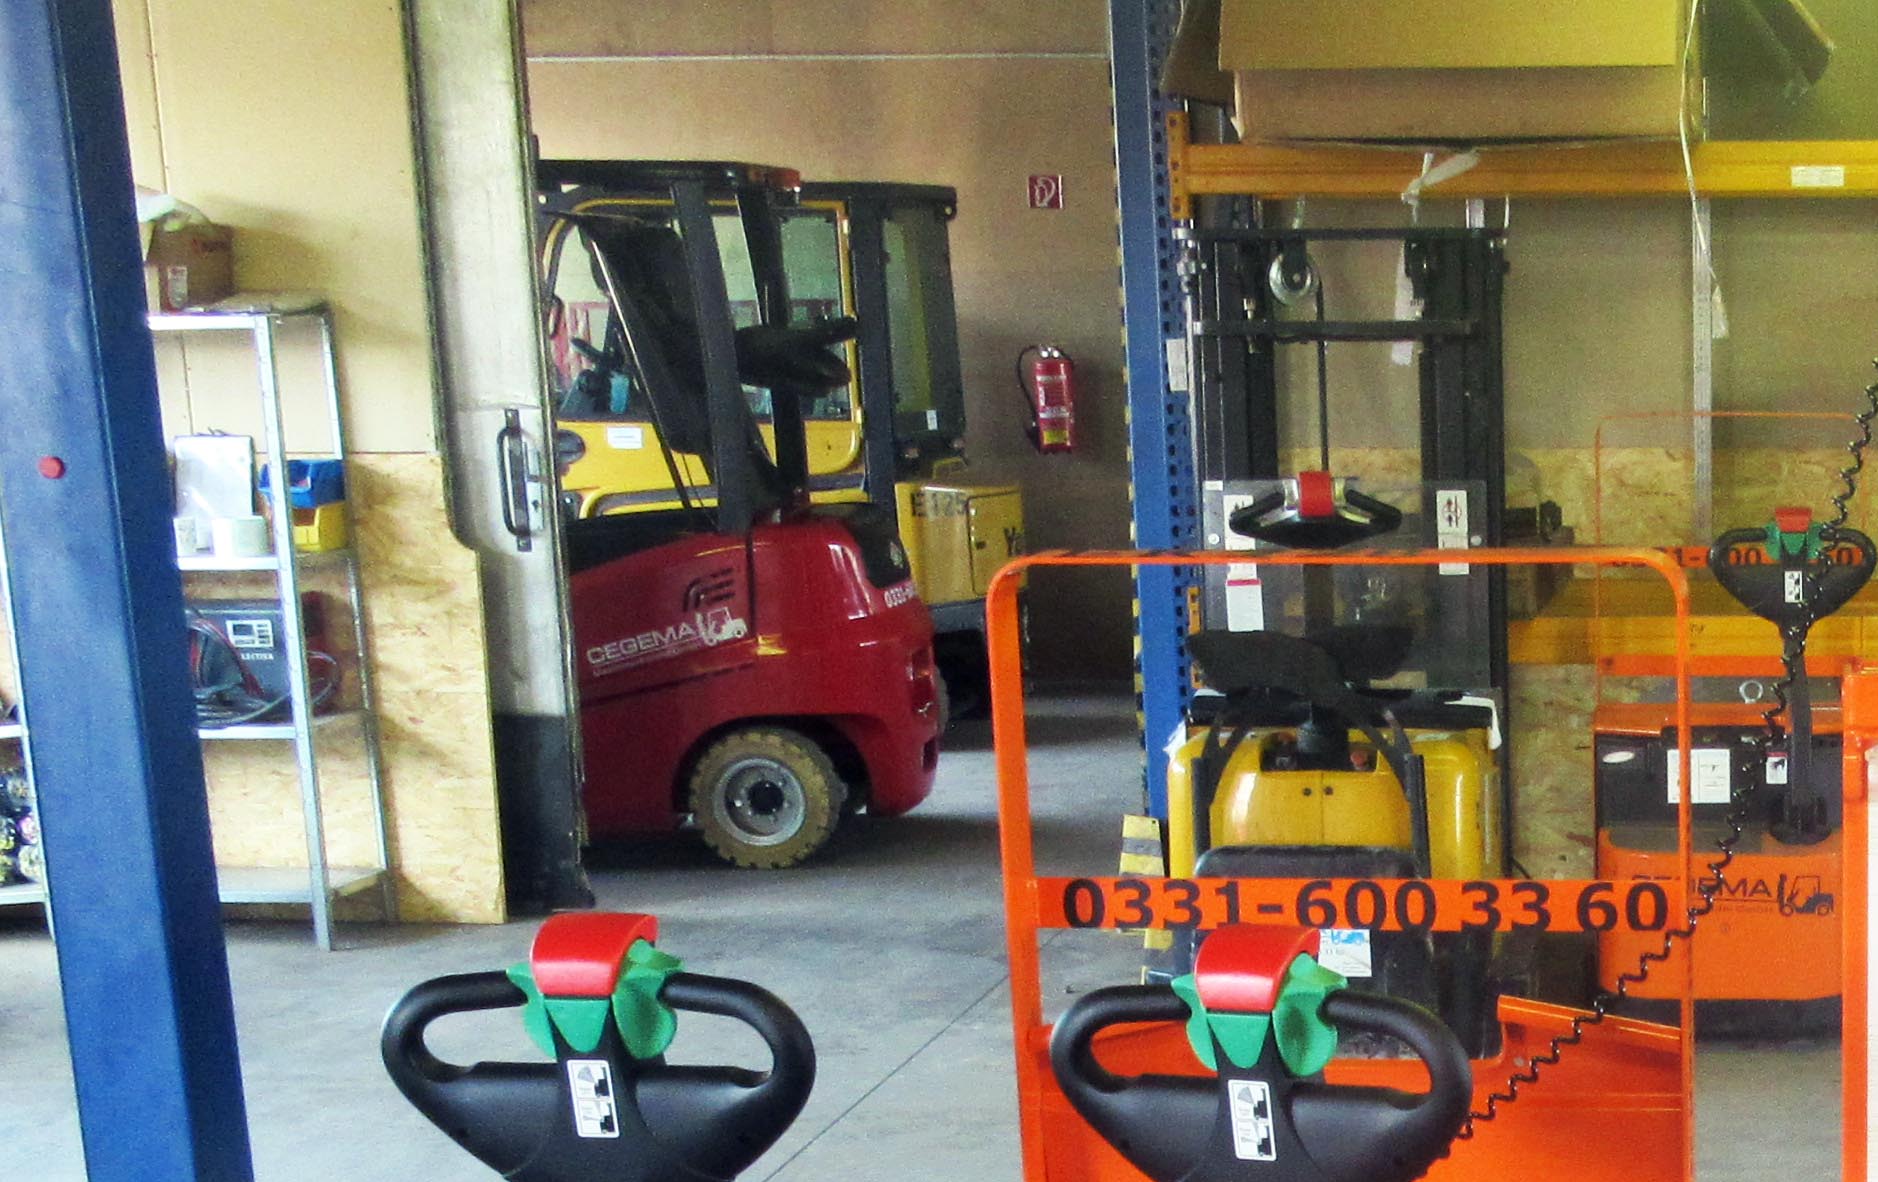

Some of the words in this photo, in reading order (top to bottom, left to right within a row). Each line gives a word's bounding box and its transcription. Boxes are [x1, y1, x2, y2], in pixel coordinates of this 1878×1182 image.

[586, 621, 697, 665] CEGEMA
[1063, 879, 1437, 931] 0331-600
[1460, 880, 1551, 932] 33
[1577, 881, 1670, 932] 60
